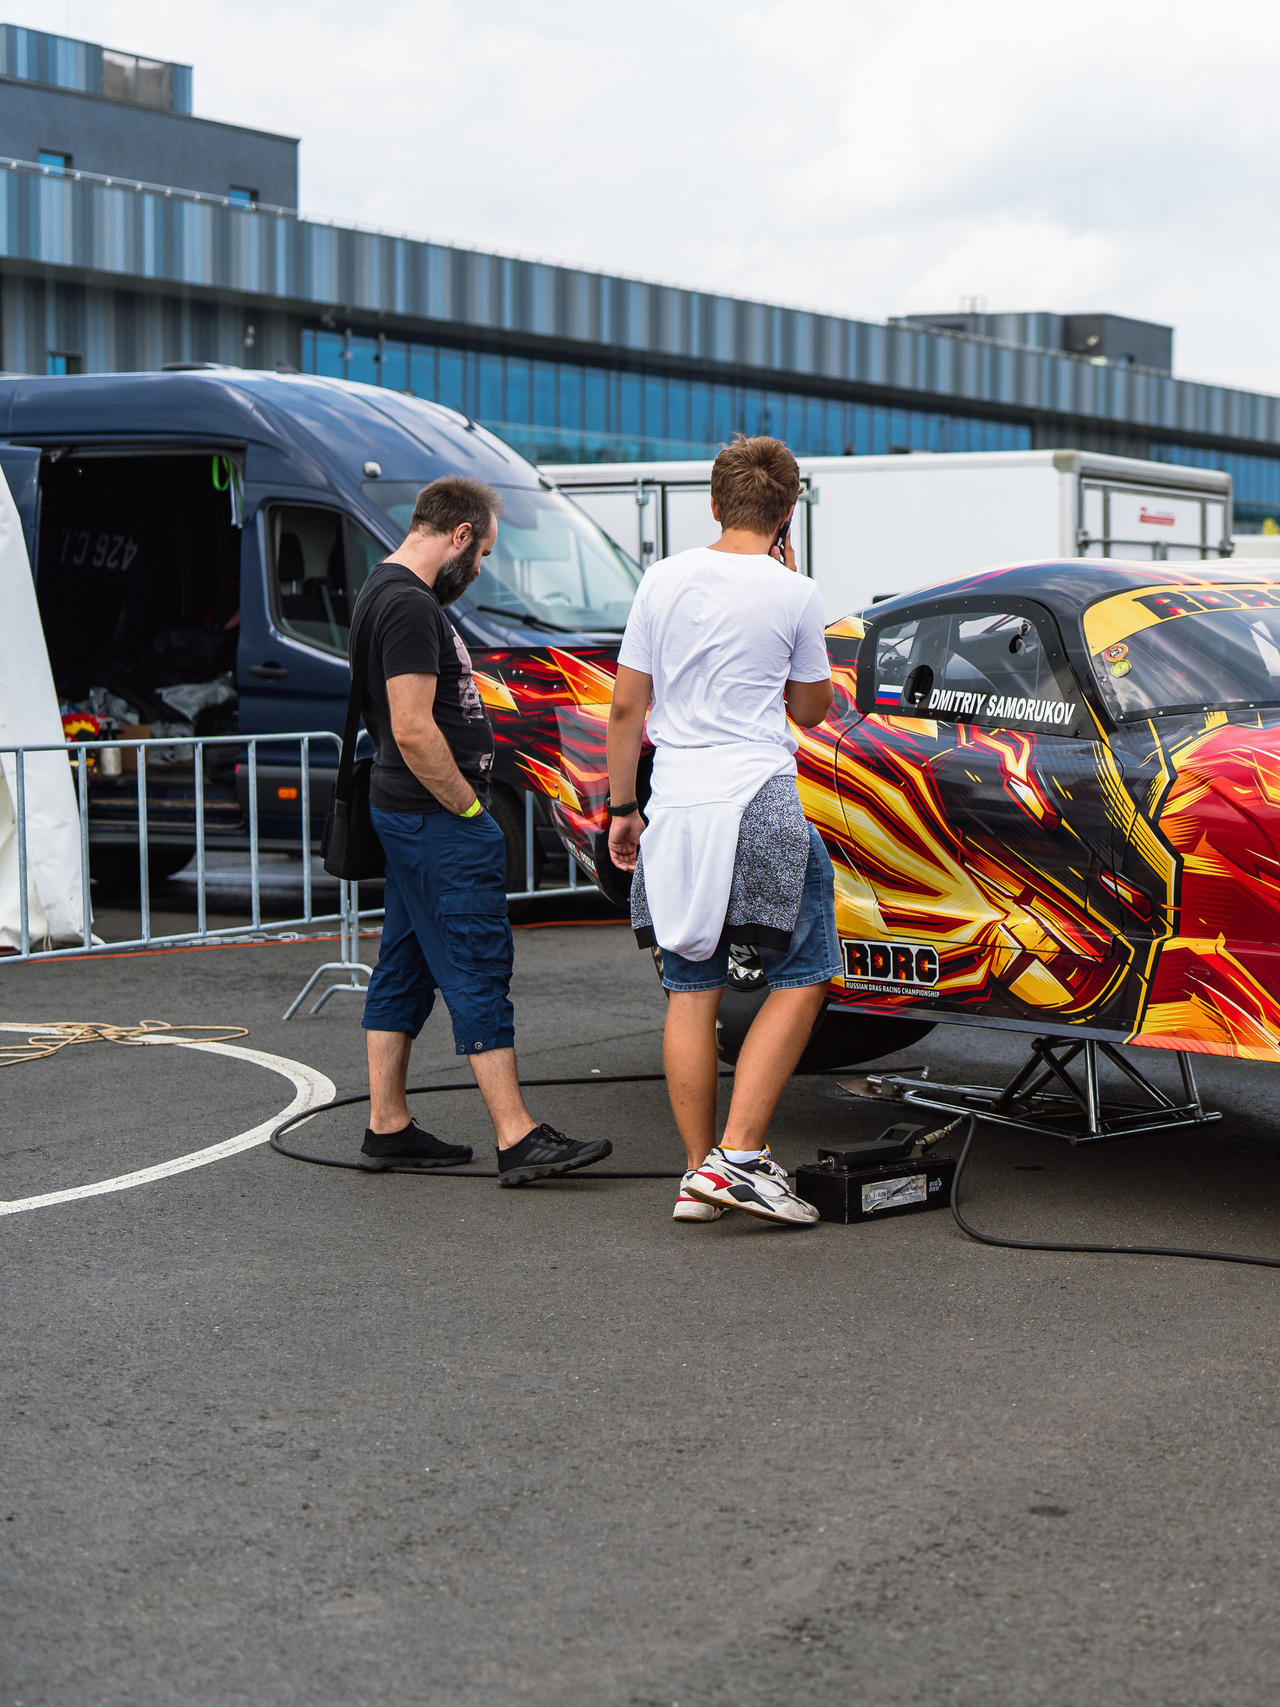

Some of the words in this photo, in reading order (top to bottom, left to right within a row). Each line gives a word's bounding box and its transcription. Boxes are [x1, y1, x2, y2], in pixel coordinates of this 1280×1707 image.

[928, 688, 987, 716] DMITRIY
[986, 695, 1076, 725] SAMORUKOV
[842, 940, 939, 986] RDRC
[846, 982, 868, 991] RUSSIAN
[869, 983, 882, 992] DRAG
[883, 985, 901, 994] RACING
[901, 987, 940, 998] CHAMPIONSHIP
